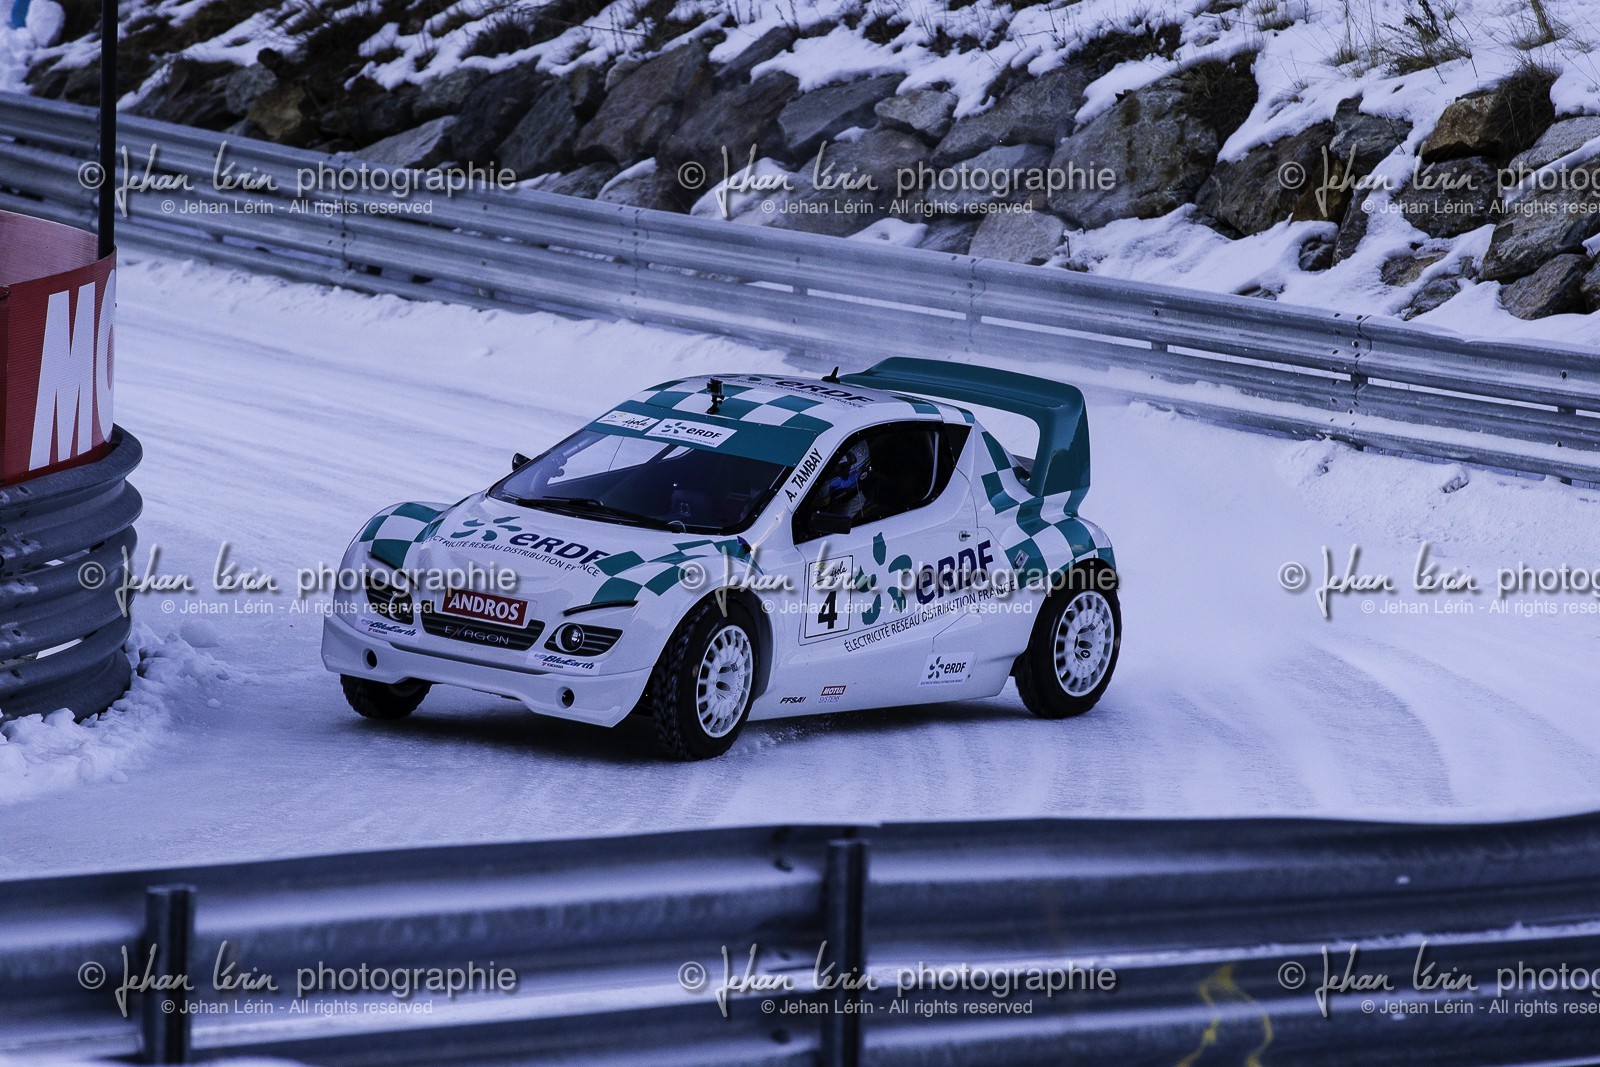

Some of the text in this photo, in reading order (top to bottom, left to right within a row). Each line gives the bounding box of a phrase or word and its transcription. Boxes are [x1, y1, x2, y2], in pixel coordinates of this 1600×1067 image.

[686, 427, 722, 439] eRDF
[785, 447, 823, 503] A. TAMBAY
[503, 545, 566, 568] DISTRIBUTION
[509, 533, 611, 564] eRDF
[916, 539, 994, 605] eRDF
[448, 592, 521, 622] ANDROS
[817, 590, 838, 630] 4
[891, 613, 921, 635] RESEAU
[921, 593, 976, 622] DISTRIBUTION
[978, 580, 1017, 601] FRANCE
[369, 621, 417, 636] BluEarth
[543, 656, 594, 669] BluEarth
[944, 662, 967, 674] eRDF
[822, 687, 845, 695] MOTUL
